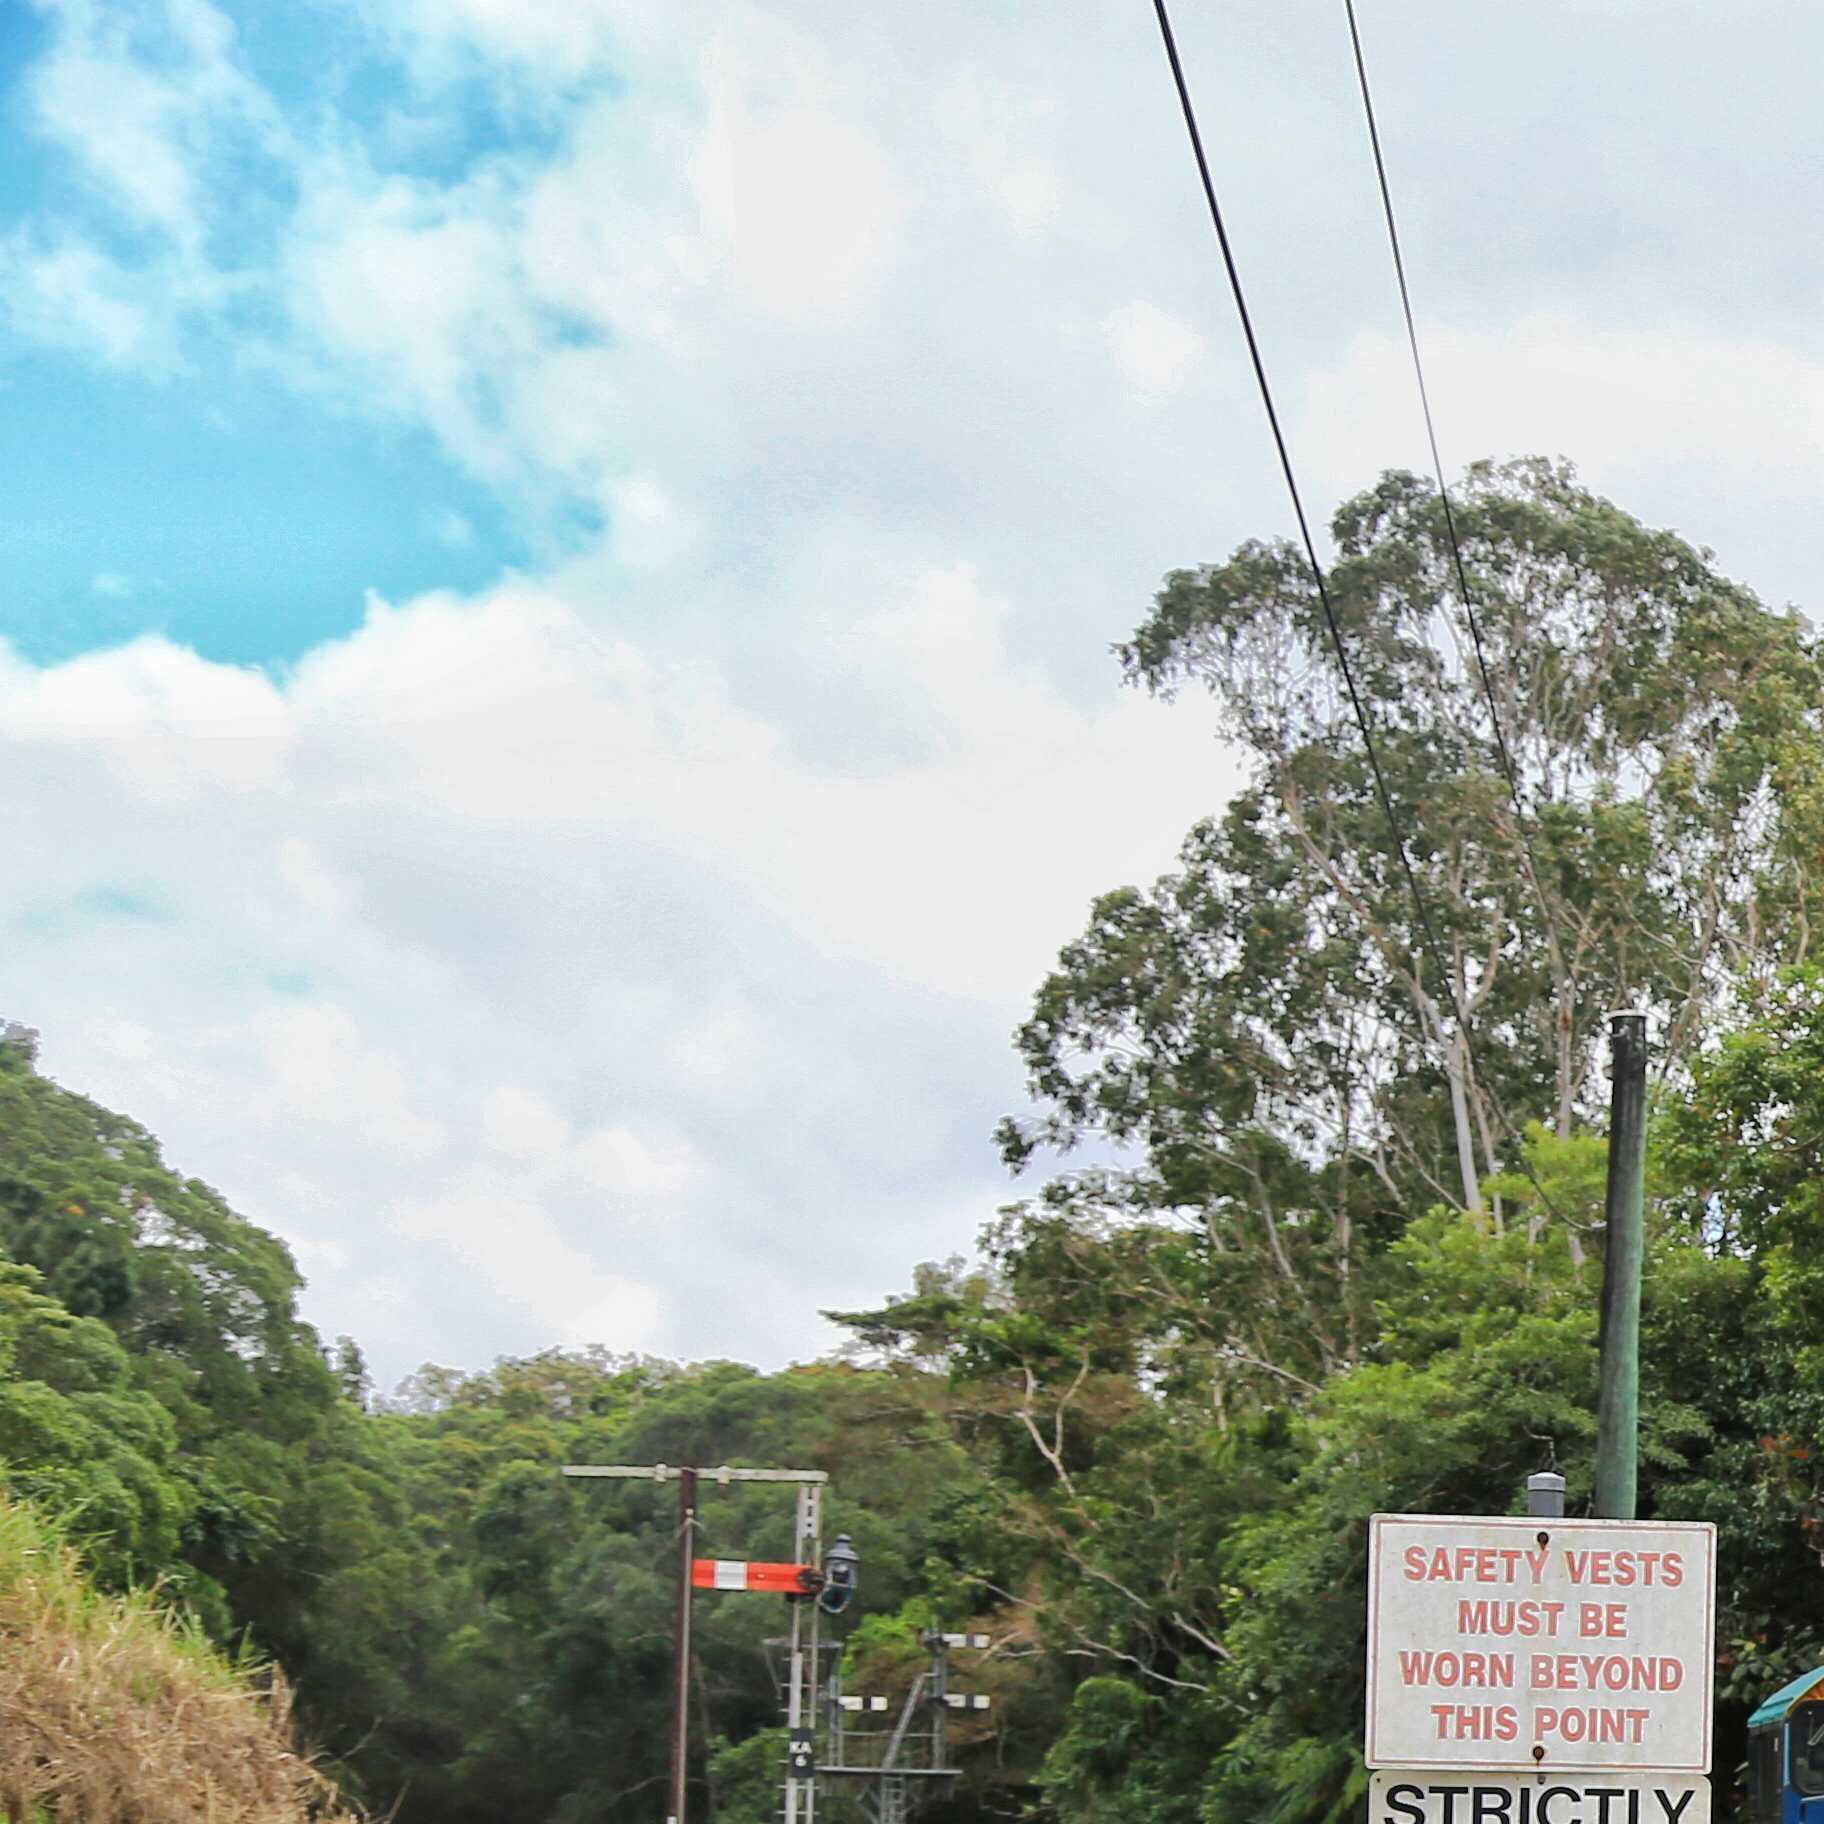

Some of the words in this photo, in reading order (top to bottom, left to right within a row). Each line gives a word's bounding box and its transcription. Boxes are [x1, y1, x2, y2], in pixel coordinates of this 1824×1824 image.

[1402, 1545, 1549, 1585] SAFETY
[1566, 1550, 1684, 1587] VESTS
[1458, 1601, 1564, 1636] MUST
[1580, 1603, 1628, 1638] BE
[1399, 1651, 1515, 1688] WORN
[1531, 1655, 1684, 1692] BEYOND
[1431, 1705, 1519, 1742] THIS
[1535, 1707, 1651, 1744] POINT
